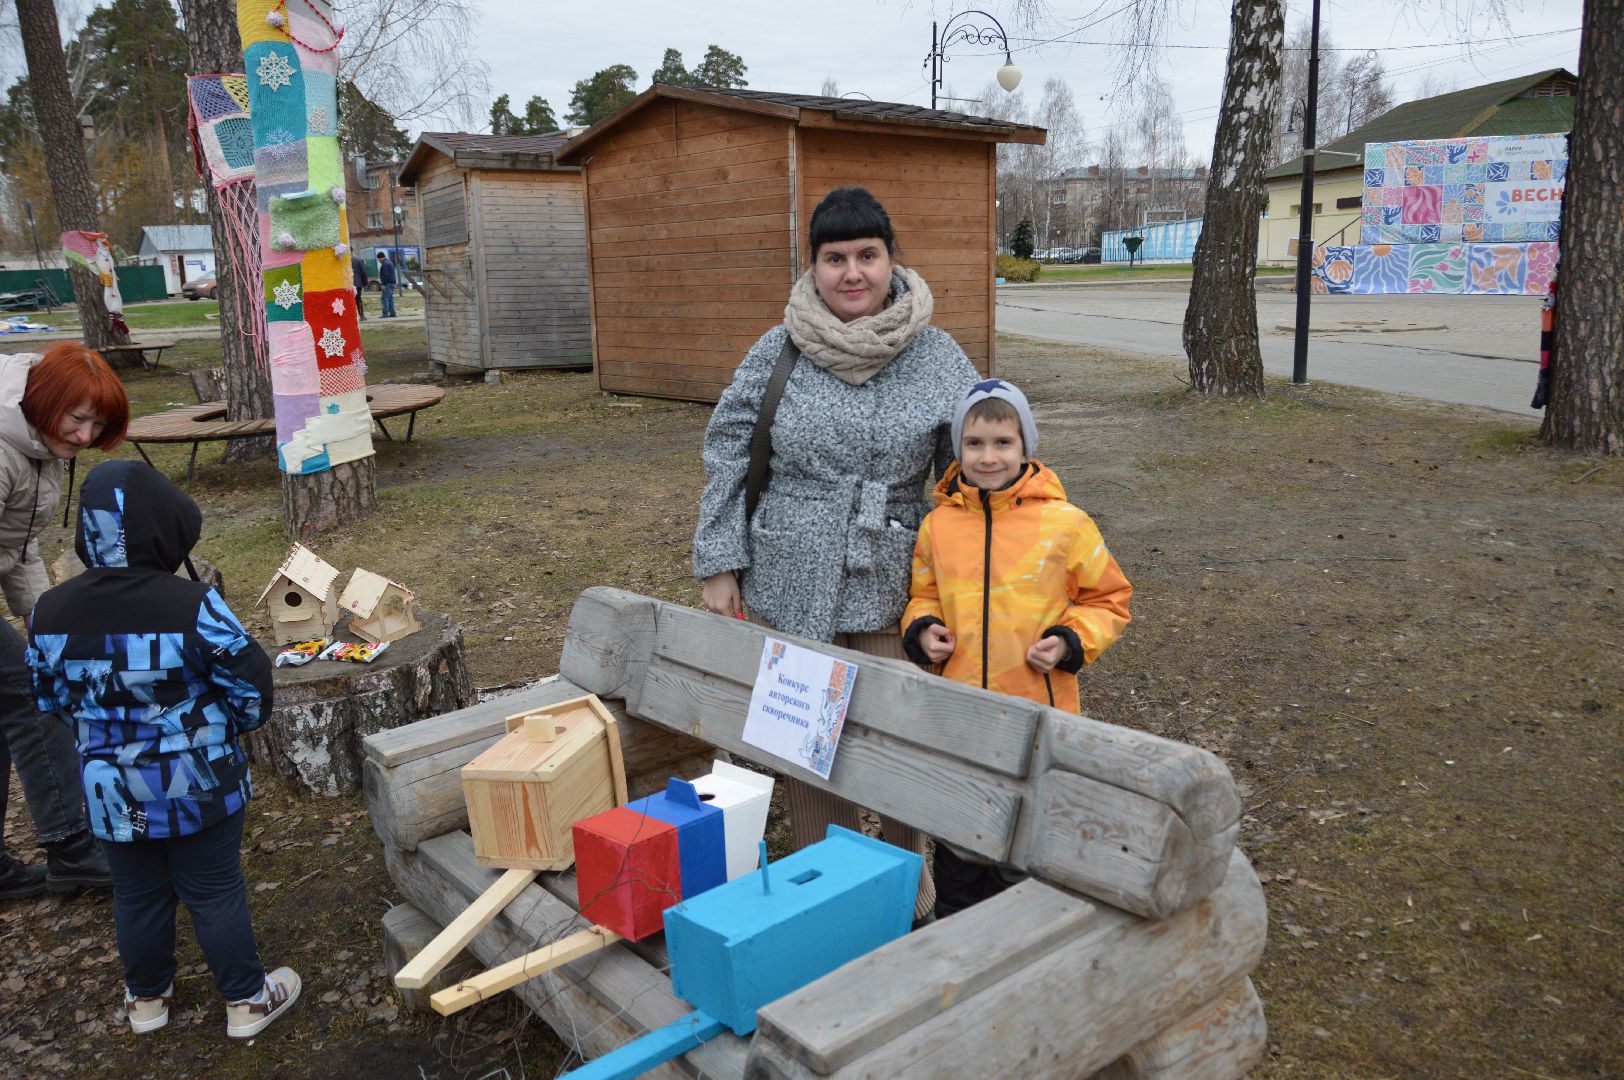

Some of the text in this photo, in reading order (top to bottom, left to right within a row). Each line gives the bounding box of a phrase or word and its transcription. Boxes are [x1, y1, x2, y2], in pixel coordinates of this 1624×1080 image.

[1511, 188, 1563, 202] ВЕСН
[777, 672, 810, 694] Конкурс
[768, 689, 810, 711] авторского
[762, 704, 809, 729] скворечника
[131, 810, 148, 834] Brit
